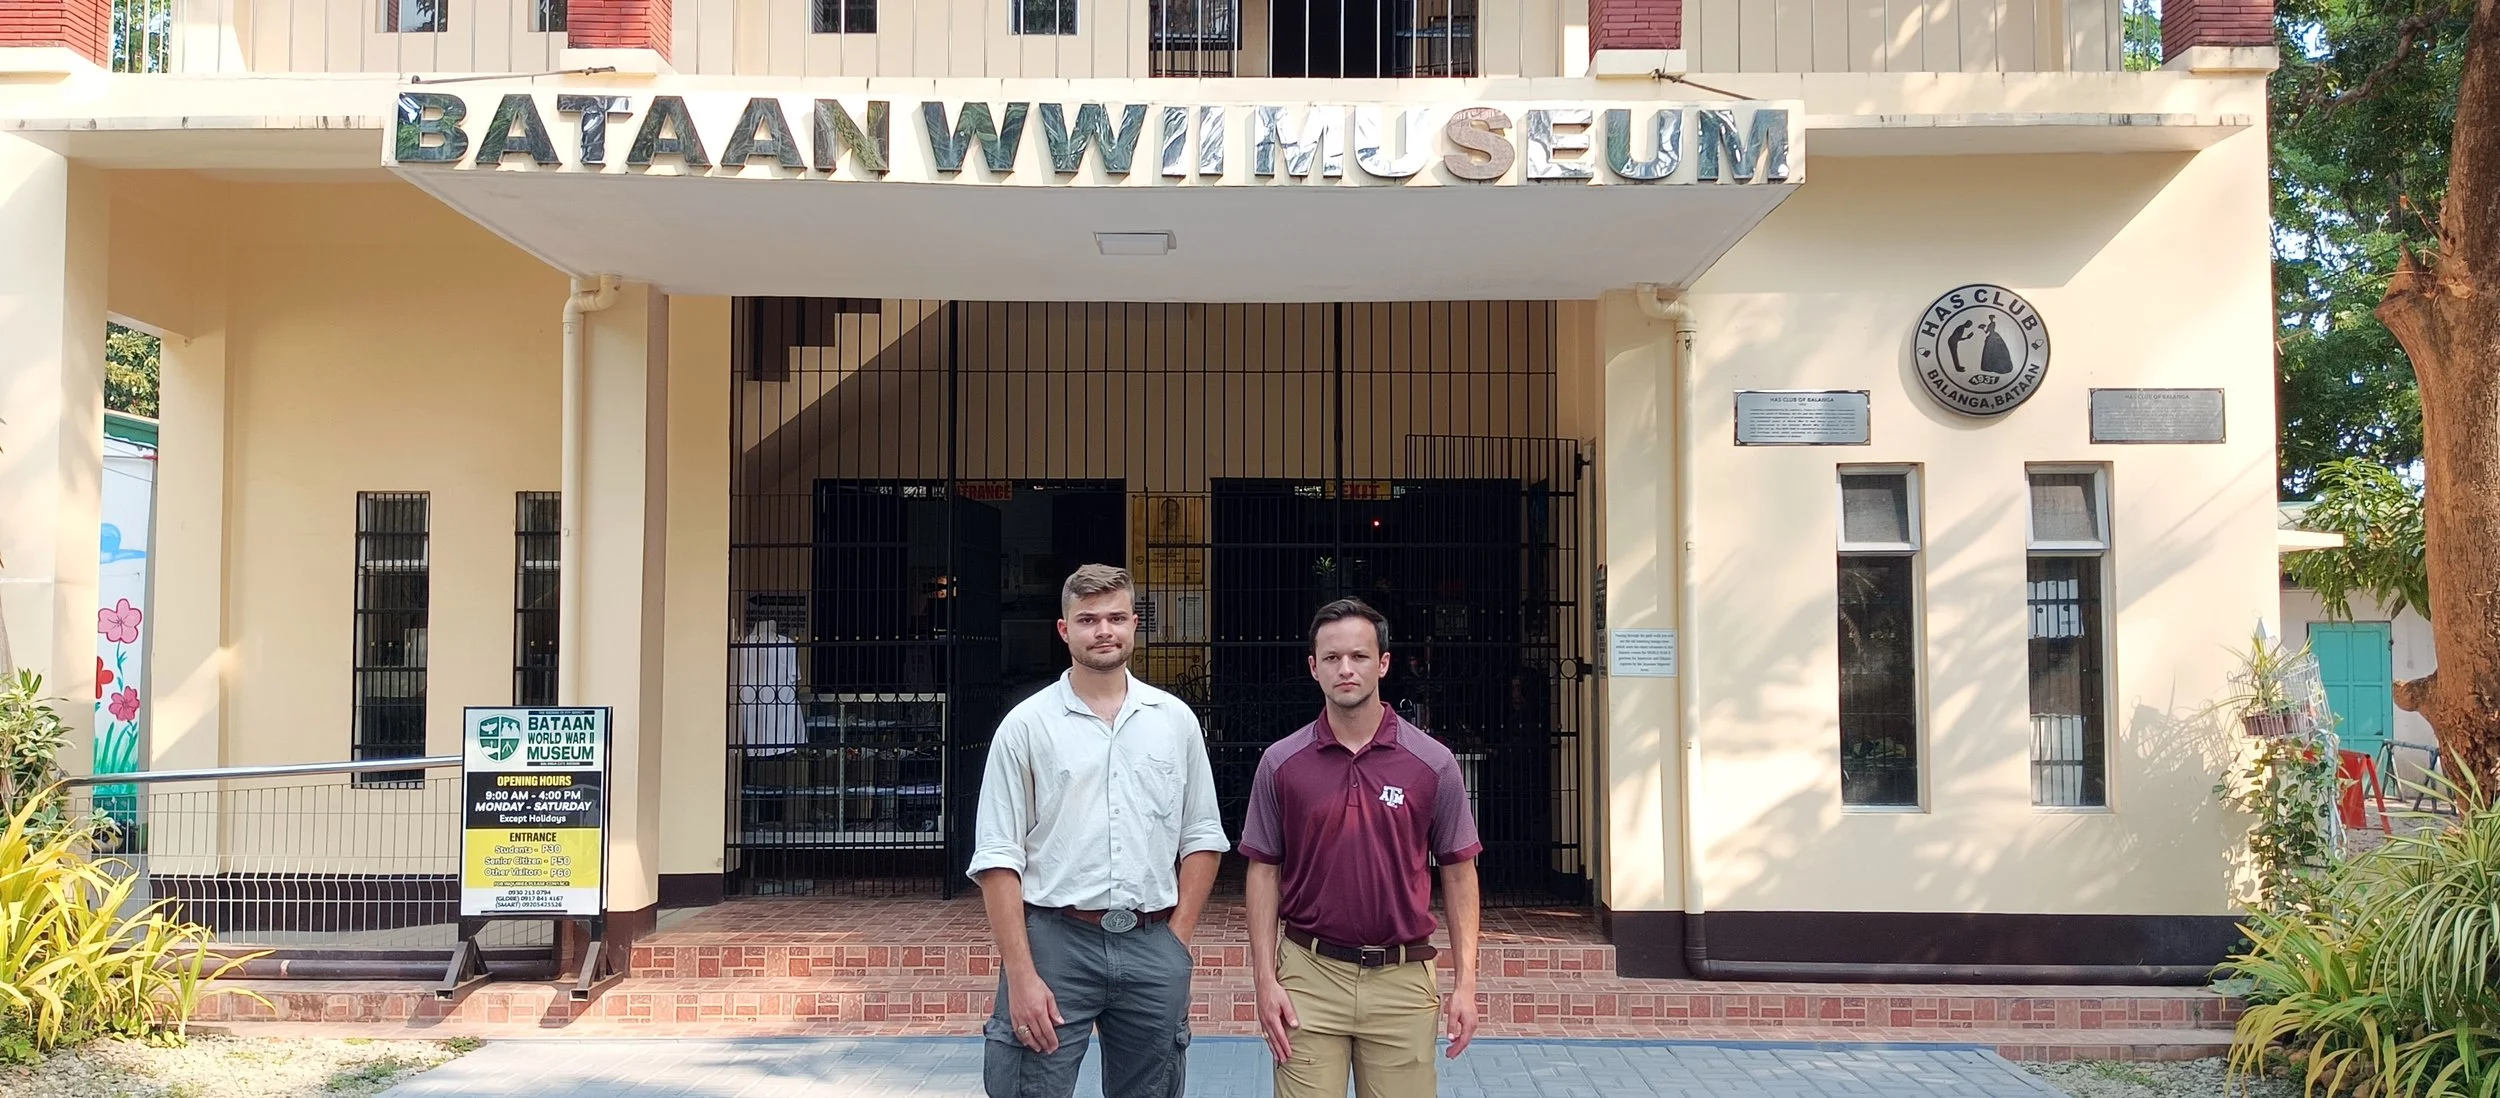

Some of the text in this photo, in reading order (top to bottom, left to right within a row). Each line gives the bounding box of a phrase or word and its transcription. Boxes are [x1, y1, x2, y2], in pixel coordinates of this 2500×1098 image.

[396, 92, 890, 176] BATAAN
[1255, 104, 1791, 180] MUSEUM
[1921, 288, 2038, 338] HAS CLUB
[1342, 484, 1380, 499] EXIT
[528, 716, 595, 731] BATAAN
[528, 732, 595, 745] WORLD WAR II
[527, 746, 594, 760] MUSEUM
[497, 776, 572, 787] OPENING HOURS
[485, 791, 509, 801] 9:00
[510, 791, 529, 800] AM
[538, 791, 561, 800] 4:00
[564, 791, 581, 800] PM
[475, 802, 525, 812] MONDAY
[533, 802, 592, 812] SATURDAY
[499, 815, 566, 824] Except Holidays
[509, 832, 557, 842] ENTRANCE
[494, 845, 533, 854] Students
[541, 844, 562, 854] P30
[484, 857, 512, 865] Senior
[512, 856, 543, 866] Citizen
[550, 856, 571, 866] P50
[484, 868, 509, 877] Other
[510, 868, 542, 877] Visitors
[550, 868, 571, 878] P60
